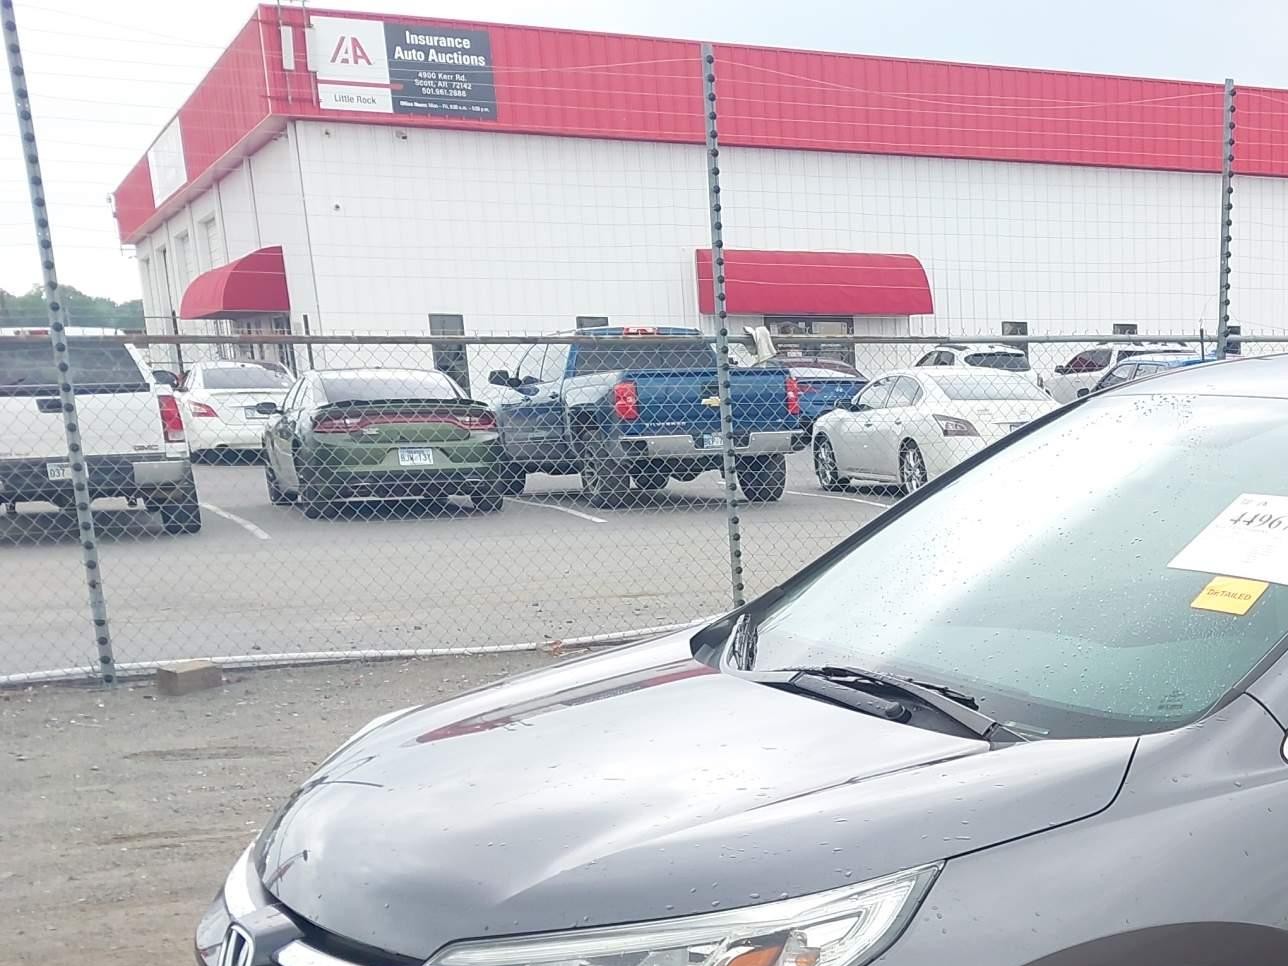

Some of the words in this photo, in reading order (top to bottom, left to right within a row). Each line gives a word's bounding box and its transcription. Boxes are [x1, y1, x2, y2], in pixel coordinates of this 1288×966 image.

[405, 30, 471, 49] Insurance
[394, 46, 425, 61] Auto
[427, 48, 486, 66] Auctions
[334, 94, 355, 104] Little
[356, 95, 377, 105] Rock
